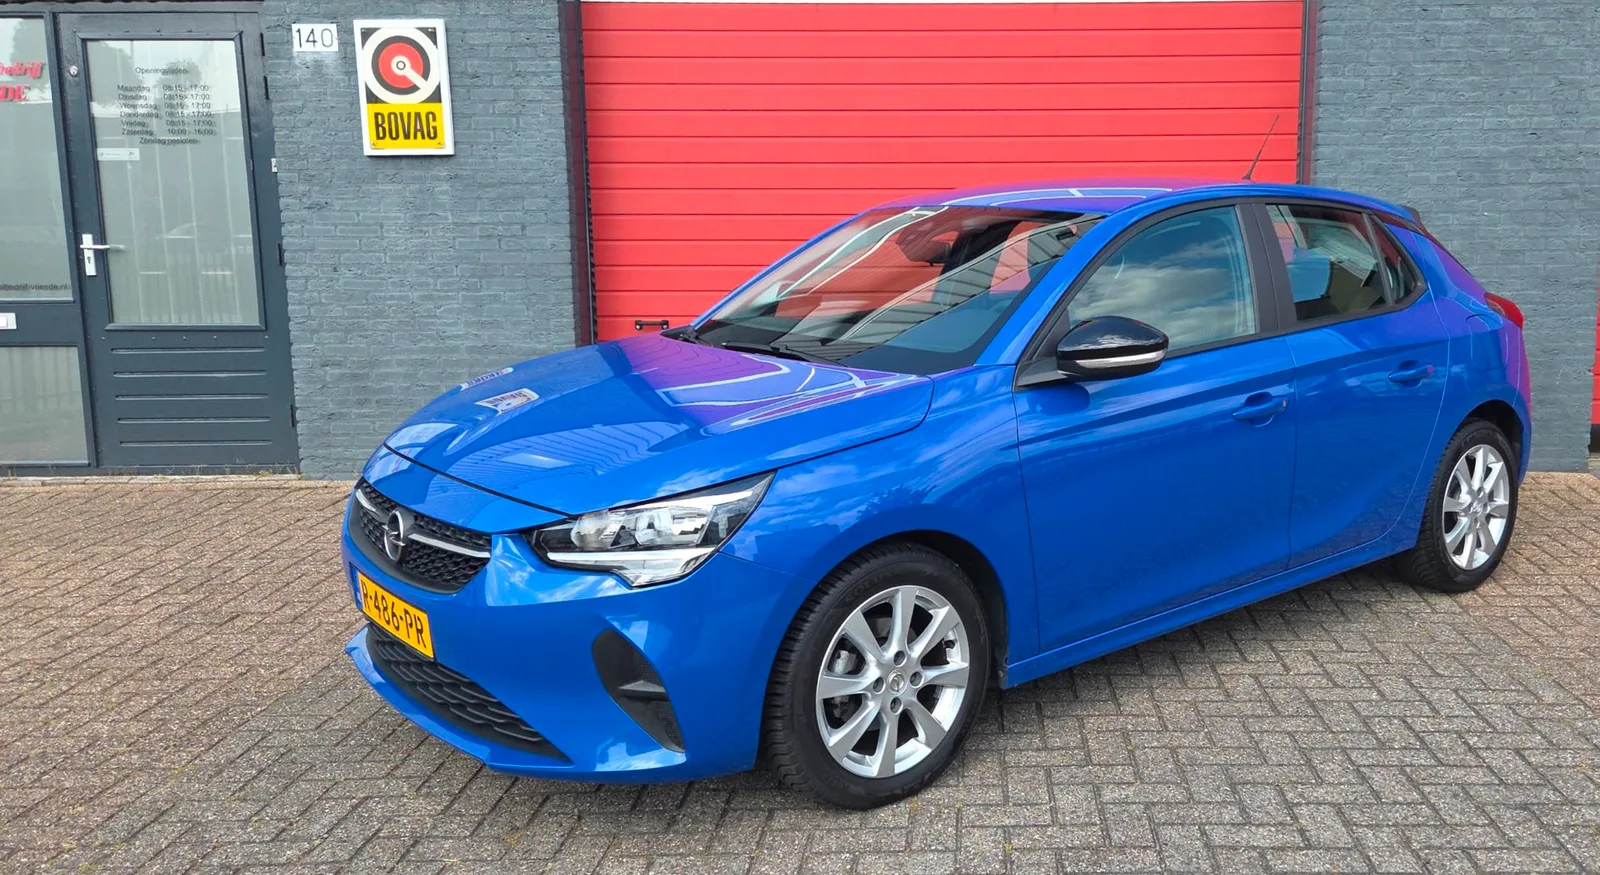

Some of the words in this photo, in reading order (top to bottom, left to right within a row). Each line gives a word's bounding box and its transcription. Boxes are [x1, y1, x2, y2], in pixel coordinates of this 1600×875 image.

[296, 28, 334, 48] 140
[117, 84, 150, 92] Maandag
[121, 128, 153, 136] Zaterdag
[373, 111, 438, 141] BOVAG
[139, 137, 166, 145] Zondag
[360, 579, 427, 649] R-486-PR
